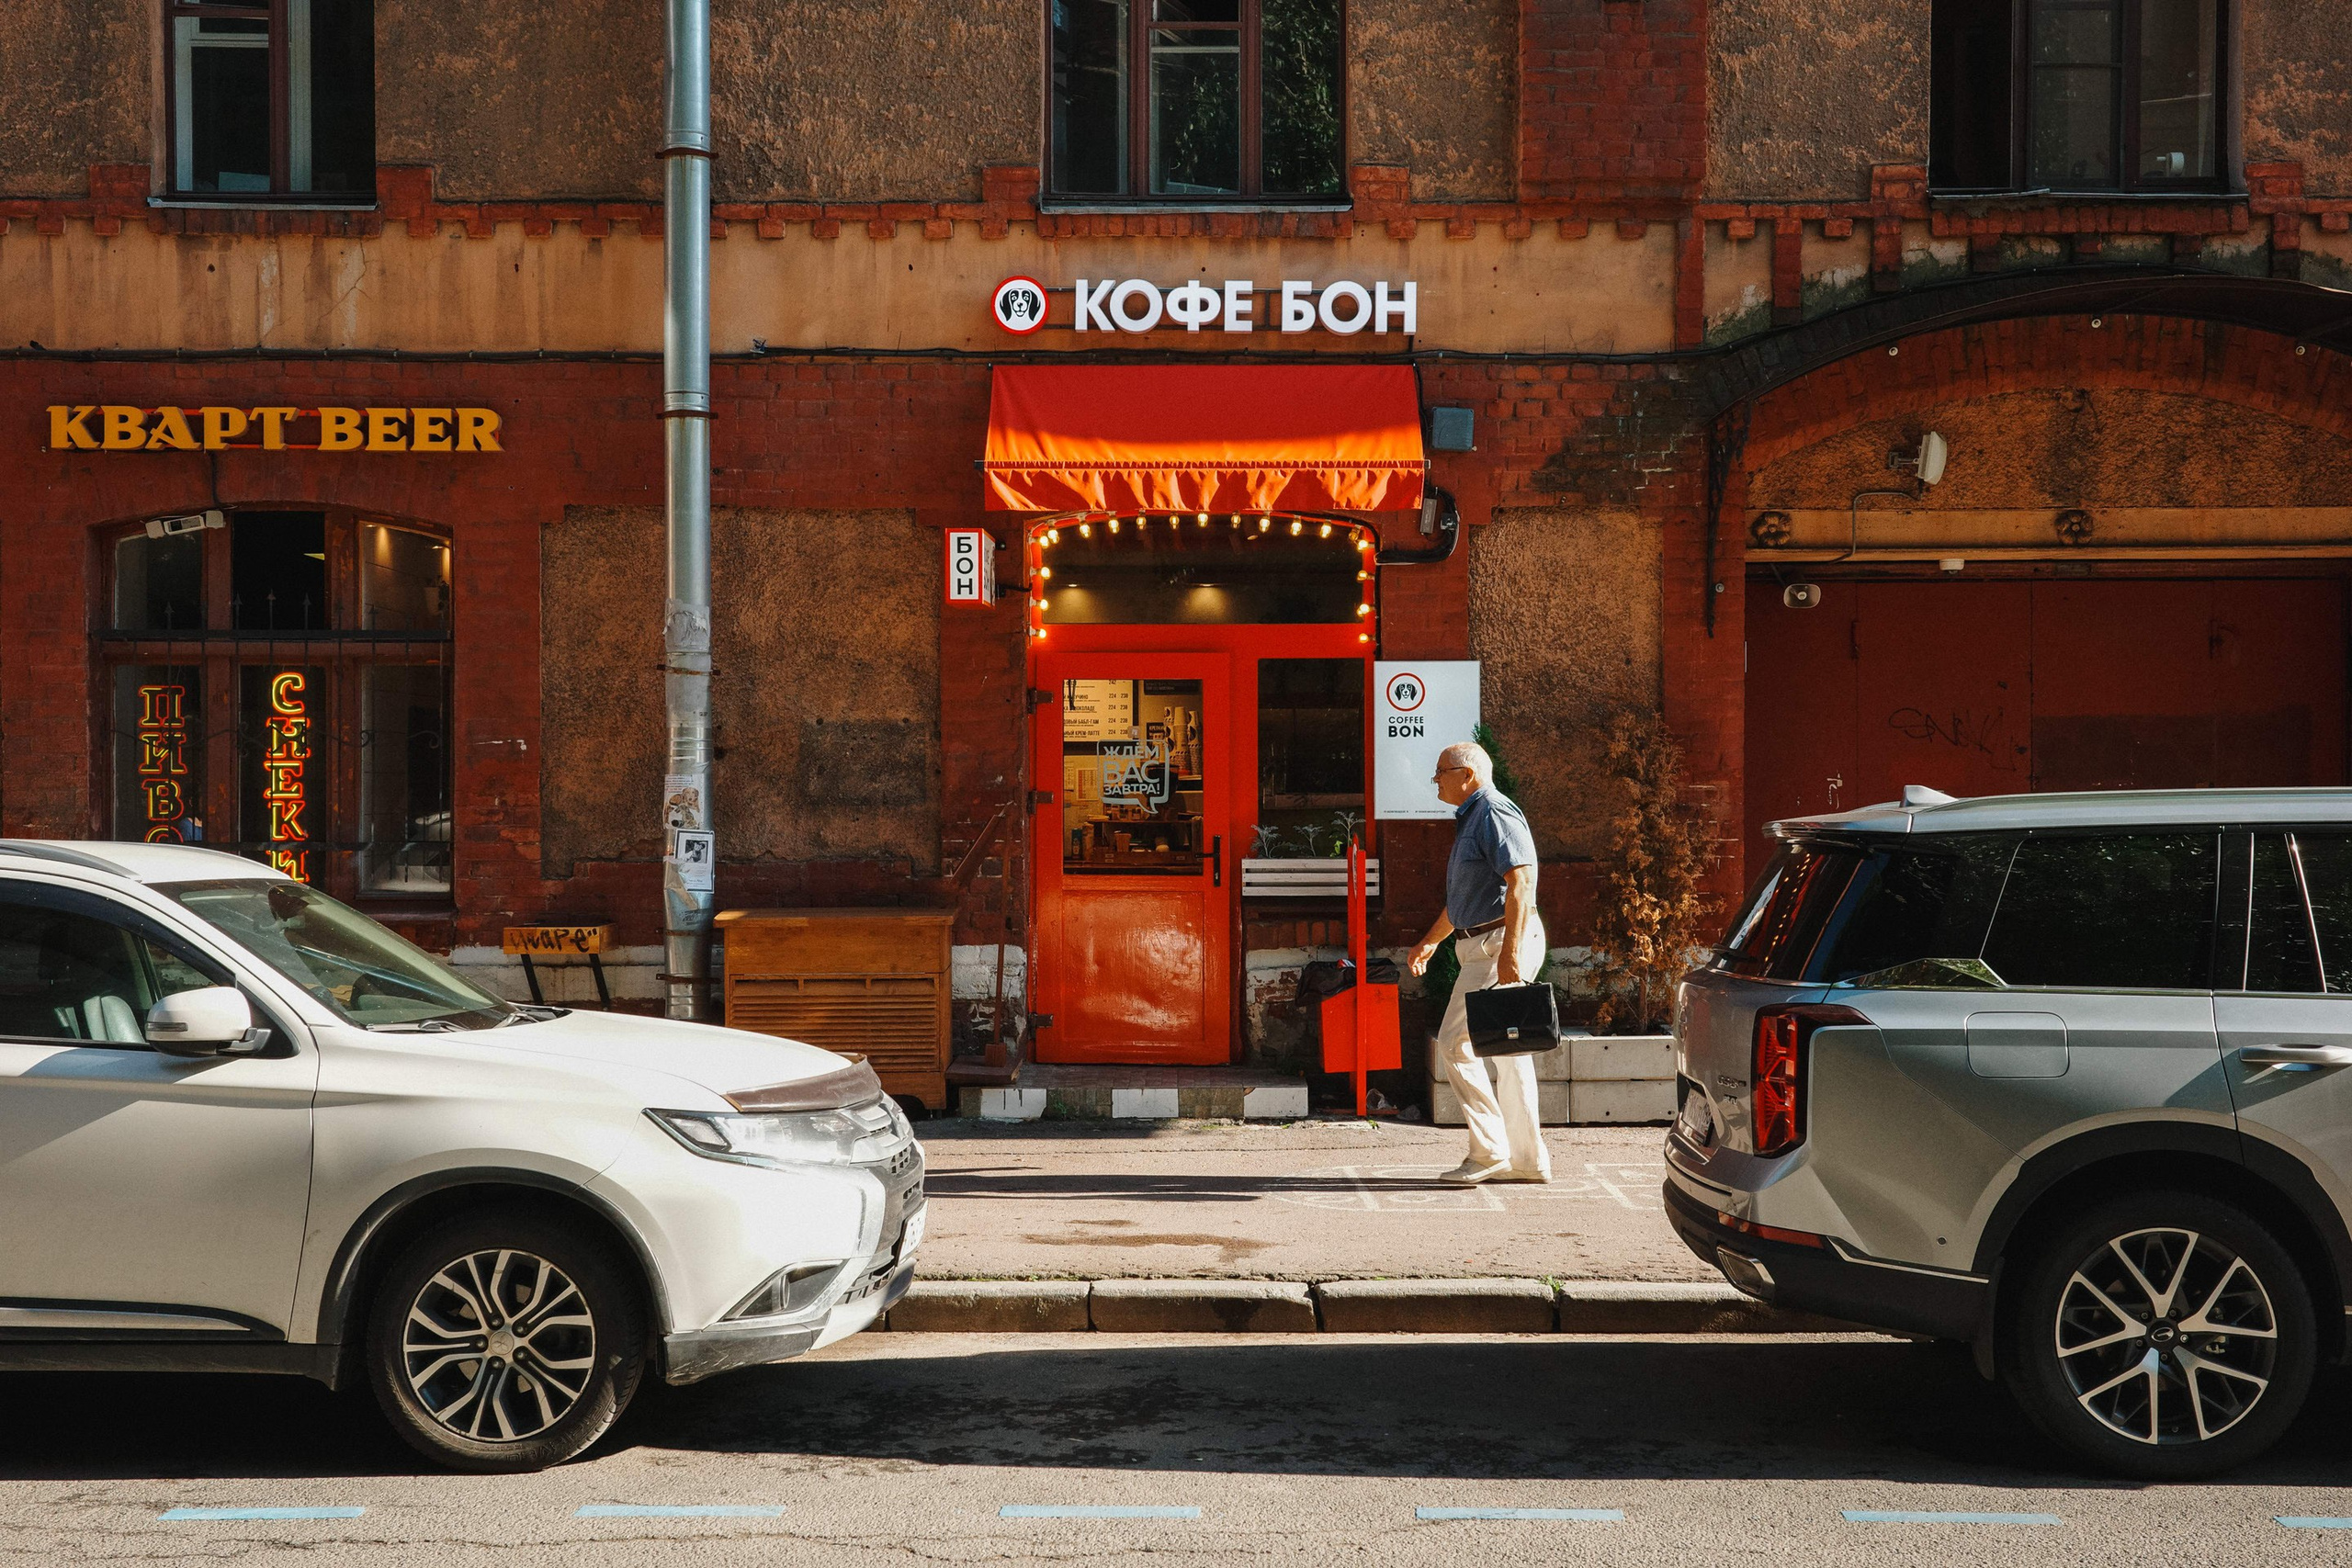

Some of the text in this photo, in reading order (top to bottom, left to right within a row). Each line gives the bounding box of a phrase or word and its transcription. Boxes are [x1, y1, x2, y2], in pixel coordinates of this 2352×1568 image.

[1075, 278, 1417, 336] КОФЕ БОН
[46, 405, 505, 452] КВАРТ BEER
[956, 536, 974, 595] БОН
[1388, 716, 1424, 724] COFFEE
[1388, 725, 1424, 738] BON
[1102, 742, 1159, 760] ЖДЁМ
[1103, 760, 1160, 784] ВАС
[1102, 784, 1160, 795] ЗАВТРА!
